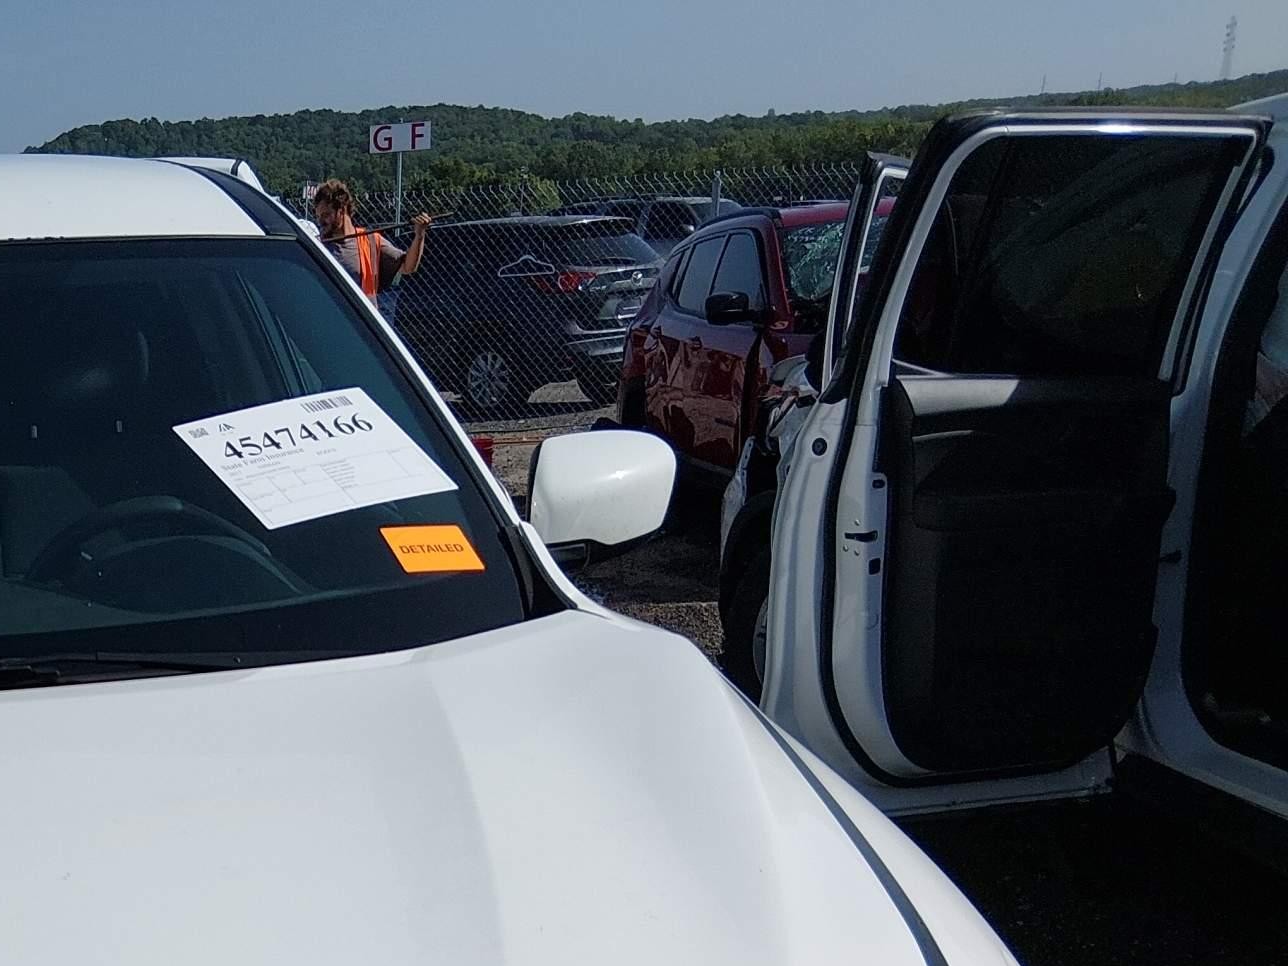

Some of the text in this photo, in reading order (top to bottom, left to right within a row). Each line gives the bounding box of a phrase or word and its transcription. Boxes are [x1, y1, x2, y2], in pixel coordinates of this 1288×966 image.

[373, 122, 425, 152] G F
[223, 412, 374, 459] 45474166
[399, 543, 465, 555] DETAILED
